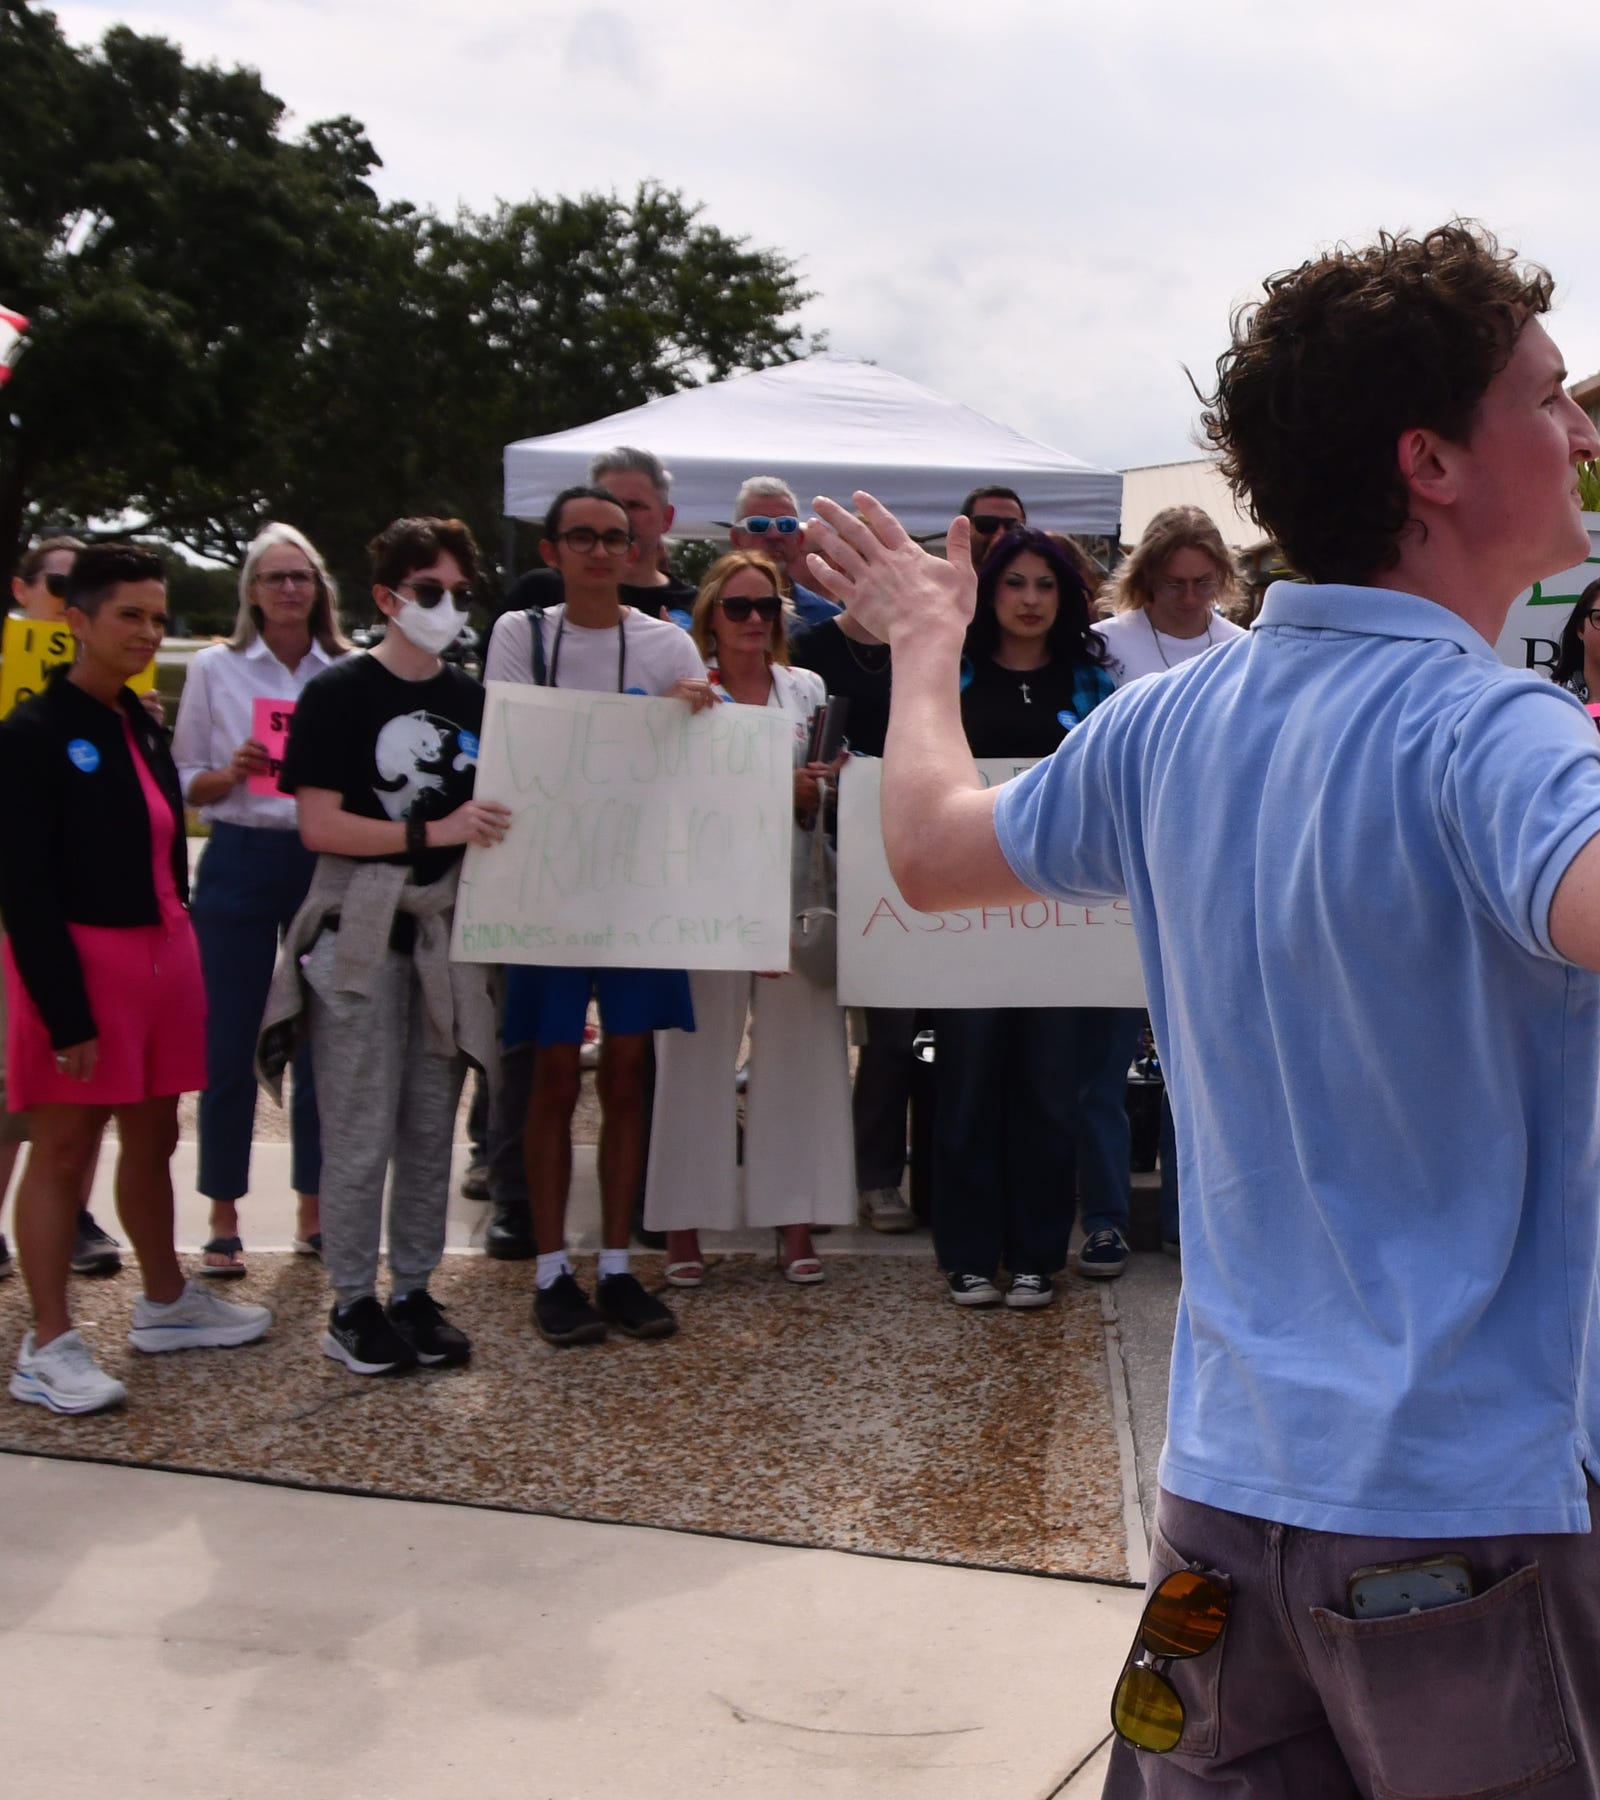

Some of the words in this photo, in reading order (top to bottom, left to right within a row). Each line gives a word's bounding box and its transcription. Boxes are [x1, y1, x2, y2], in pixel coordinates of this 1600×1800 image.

[462, 923, 557, 952] KINDNESS
[584, 925, 616, 947] not
[622, 930, 641, 946] a
[649, 914, 767, 946] CRIME
